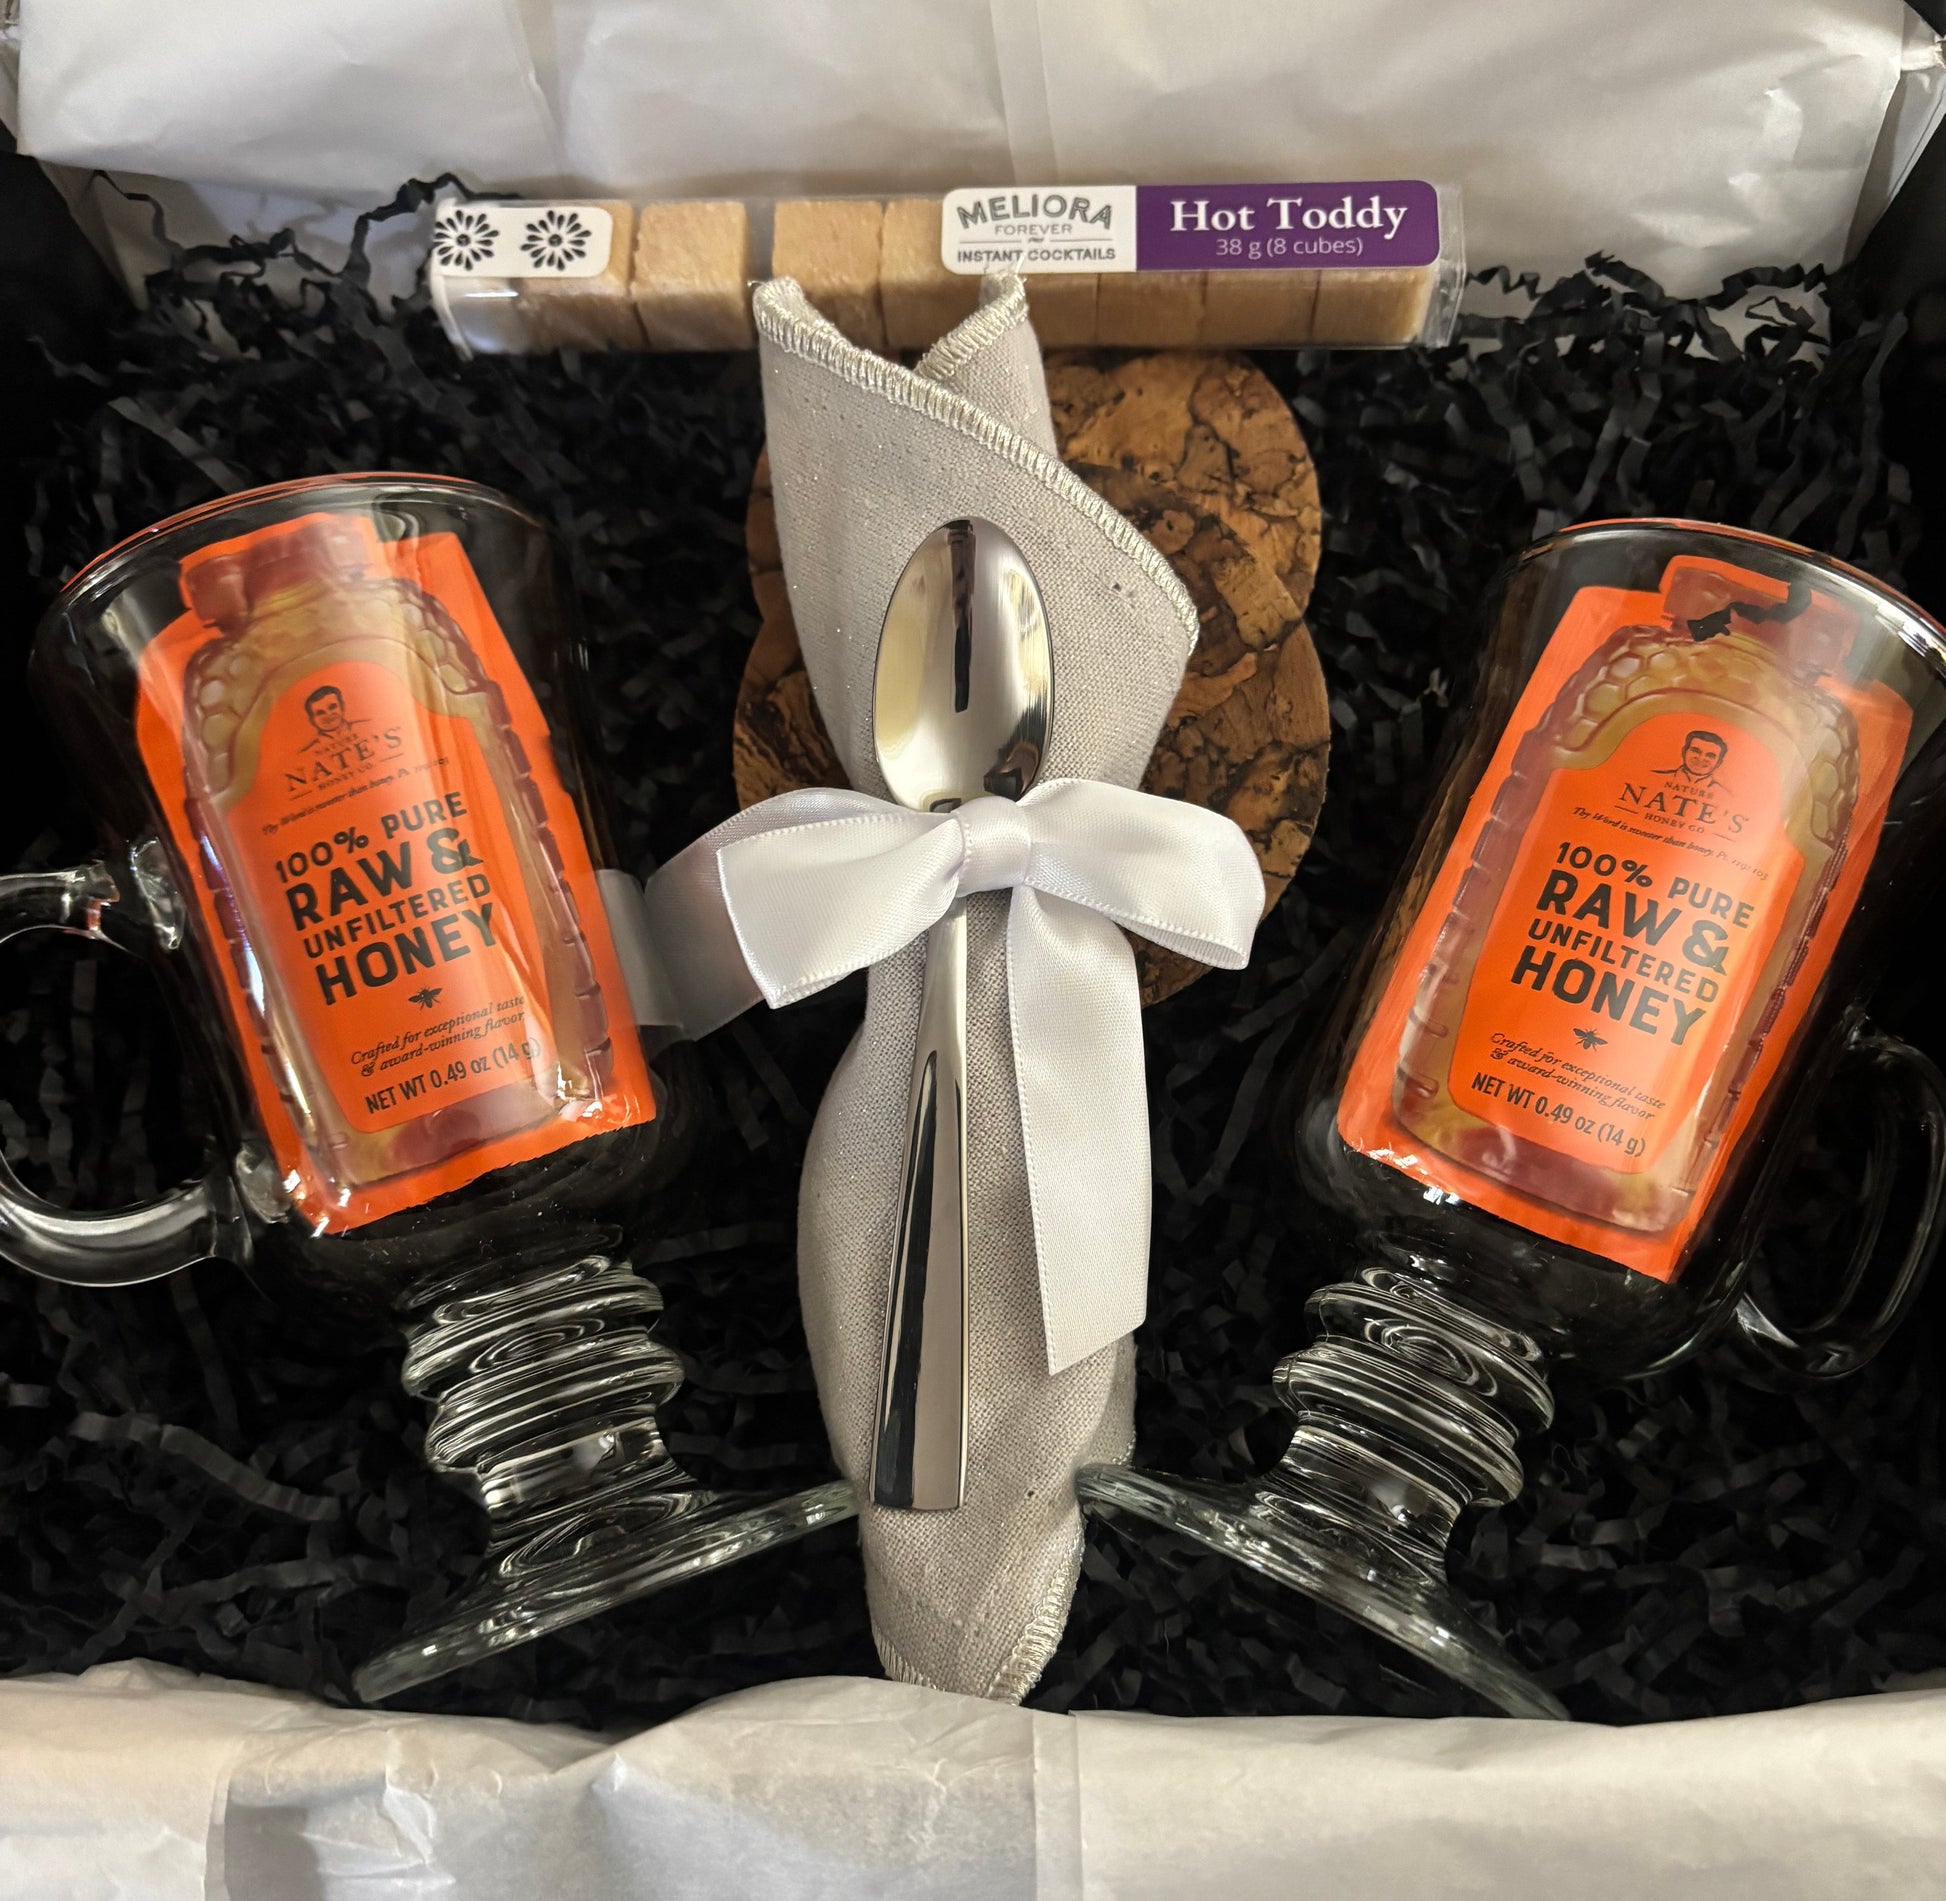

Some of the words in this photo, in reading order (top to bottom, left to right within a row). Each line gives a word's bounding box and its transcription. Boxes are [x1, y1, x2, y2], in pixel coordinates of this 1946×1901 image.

[957, 194, 1112, 230] MELIORA
[994, 224, 1073, 235] FOREVER
[1170, 200, 1255, 231] Hot
[1267, 195, 1407, 240] Toddy
[957, 250, 1023, 262] INSTANT
[1028, 248, 1116, 262] COCKTAILS
[1216, 238, 1241, 256] 38
[1248, 242, 1261, 260] g
[1267, 237, 1287, 258] (8
[1293, 236, 1364, 256] cubes)
[285, 727, 402, 791] NATE'S
[275, 826, 369, 883] 100%
[381, 791, 467, 840] PURE
[1592, 812, 1621, 828] Word
[1618, 782, 1746, 834] NATE'S
[1644, 812, 1686, 829] HONEY
[286, 841, 413, 932] RAW
[426, 827, 484, 875] &
[1556, 842, 1653, 888] 100%
[1667, 876, 1754, 929] PURE
[302, 873, 491, 959] UNFILTERED
[1536, 869, 1682, 946] RAW
[1682, 919, 1729, 976] &
[315, 902, 497, 1006] HONEY
[1528, 918, 1719, 1003] UNFILTERED
[1511, 945, 1706, 1045] HONEY
[351, 1036, 400, 1065] Crafted
[400, 1031, 422, 1050] for
[424, 1002, 493, 1038] exceptional
[497, 996, 524, 1011] taste
[360, 1061, 376, 1077] &
[379, 1025, 482, 1071] award-winning
[480, 1011, 525, 1039] flavor
[365, 1086, 397, 1114] NET
[398, 1073, 426, 1100] WT
[429, 1061, 467, 1089] 0.49
[470, 1055, 491, 1073] oz
[492, 1045, 519, 1069] (14
[1490, 1033, 1538, 1058] Crafted
[1536, 1051, 1562, 1066] for
[1561, 1060, 1634, 1096] exceptional
[1634, 1089, 1666, 1110] taste
[1490, 1048, 1507, 1061] &
[1507, 1055, 1608, 1106] award-winning
[1605, 1097, 1655, 1120] flavor
[1471, 1072, 1508, 1098] NET
[1507, 1083, 1535, 1109] WT
[1535, 1096, 1573, 1124] 0.49
[1575, 1116, 1596, 1135] oz
[1597, 1122, 1624, 1147] (14
[1624, 1137, 1646, 1158] g)
